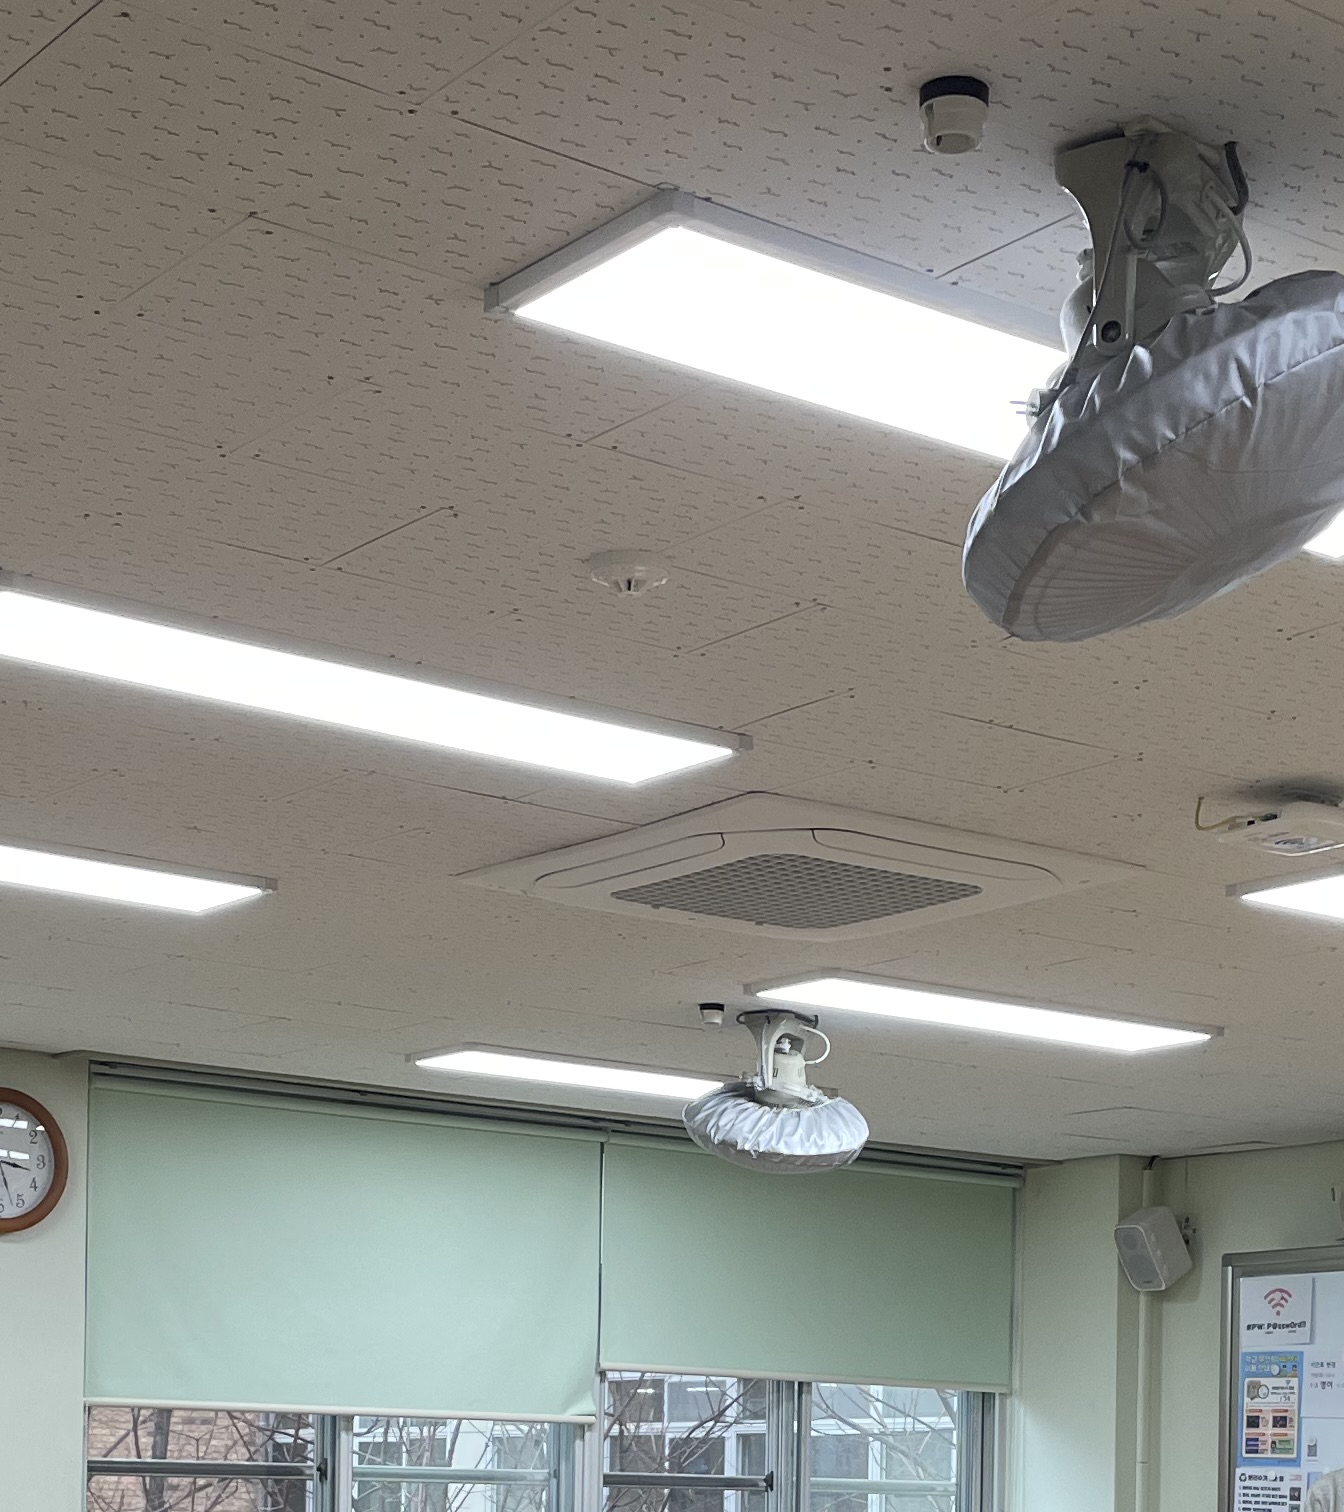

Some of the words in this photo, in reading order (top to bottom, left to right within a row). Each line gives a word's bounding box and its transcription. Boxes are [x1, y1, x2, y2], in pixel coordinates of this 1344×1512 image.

[29, 1130, 38, 1144] 2
[36, 1154, 46, 1169] 3
[29, 1177, 39, 1192] 4
[16, 1194, 25, 1208] 5
